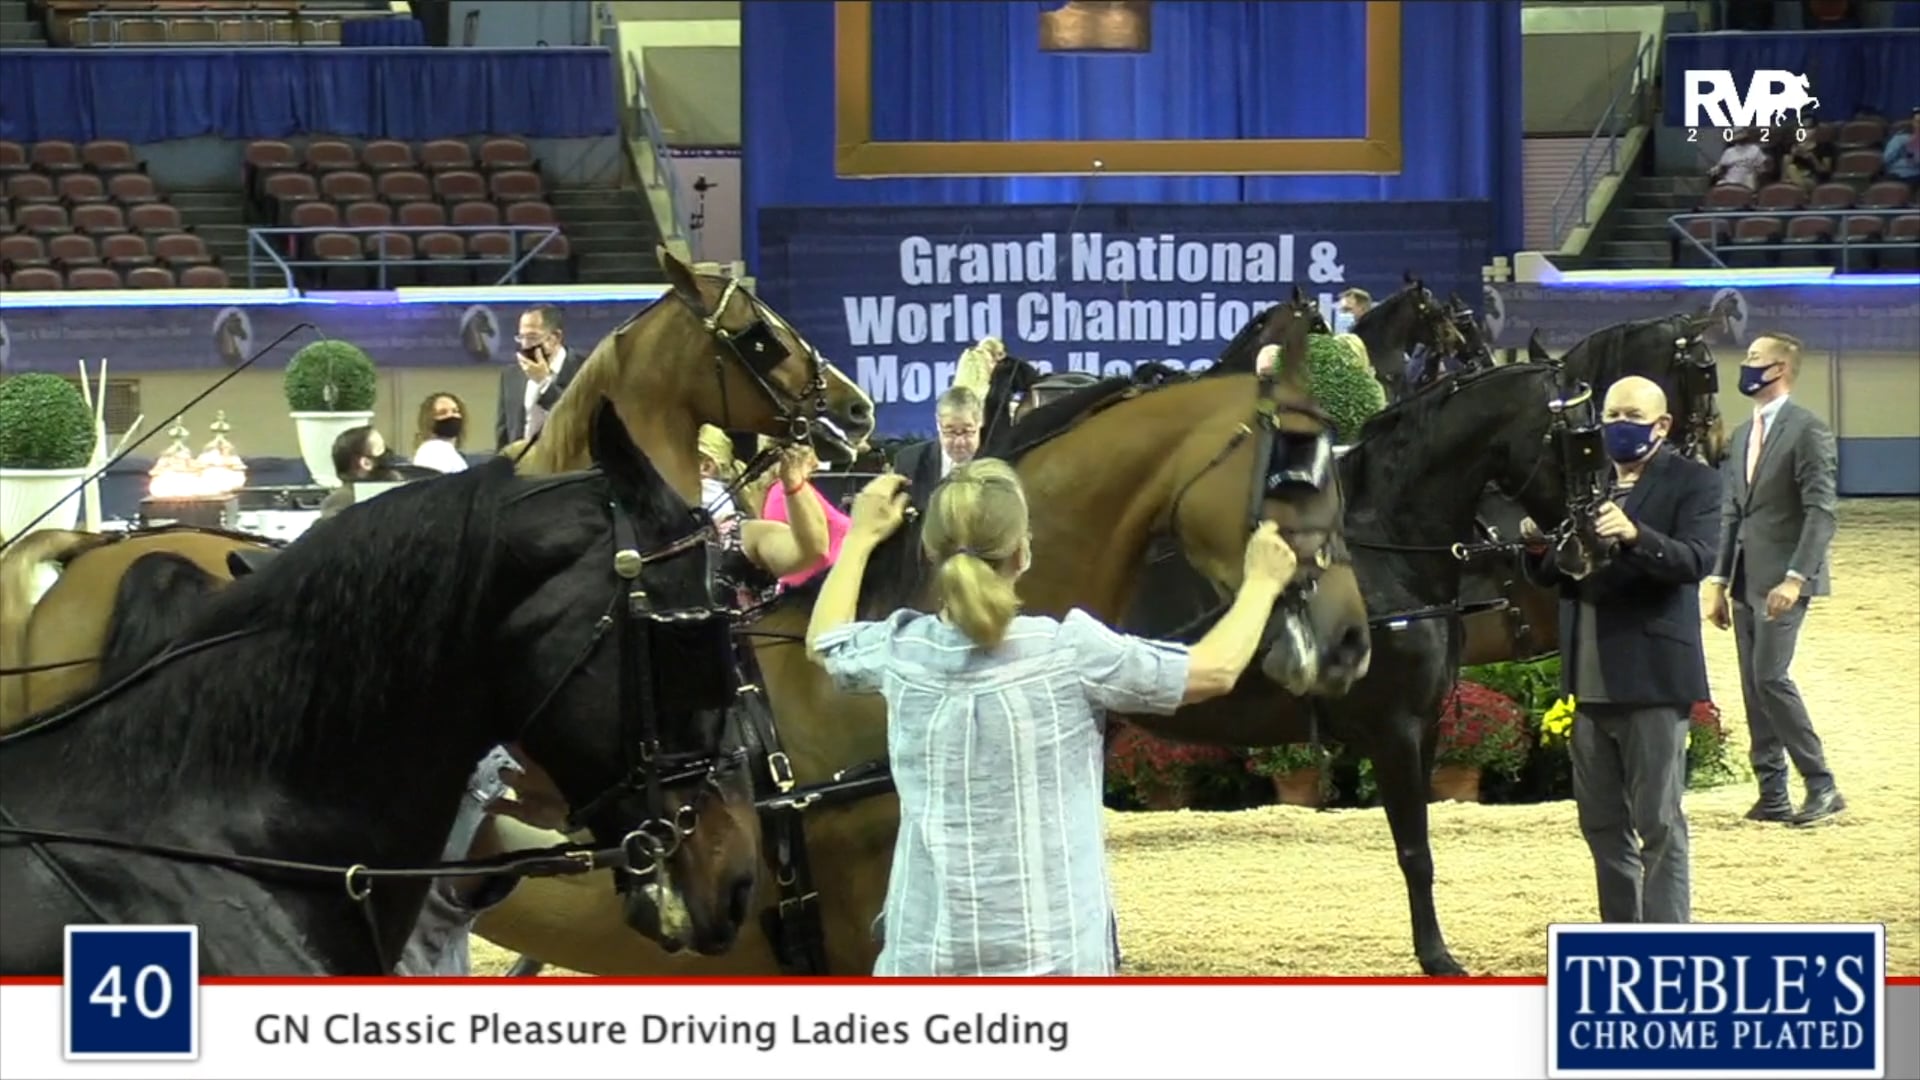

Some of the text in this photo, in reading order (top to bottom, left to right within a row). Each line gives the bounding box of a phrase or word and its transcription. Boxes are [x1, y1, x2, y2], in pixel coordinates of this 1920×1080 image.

[900, 233, 1345, 285] Grand National &
[843, 293, 1002, 346] World
